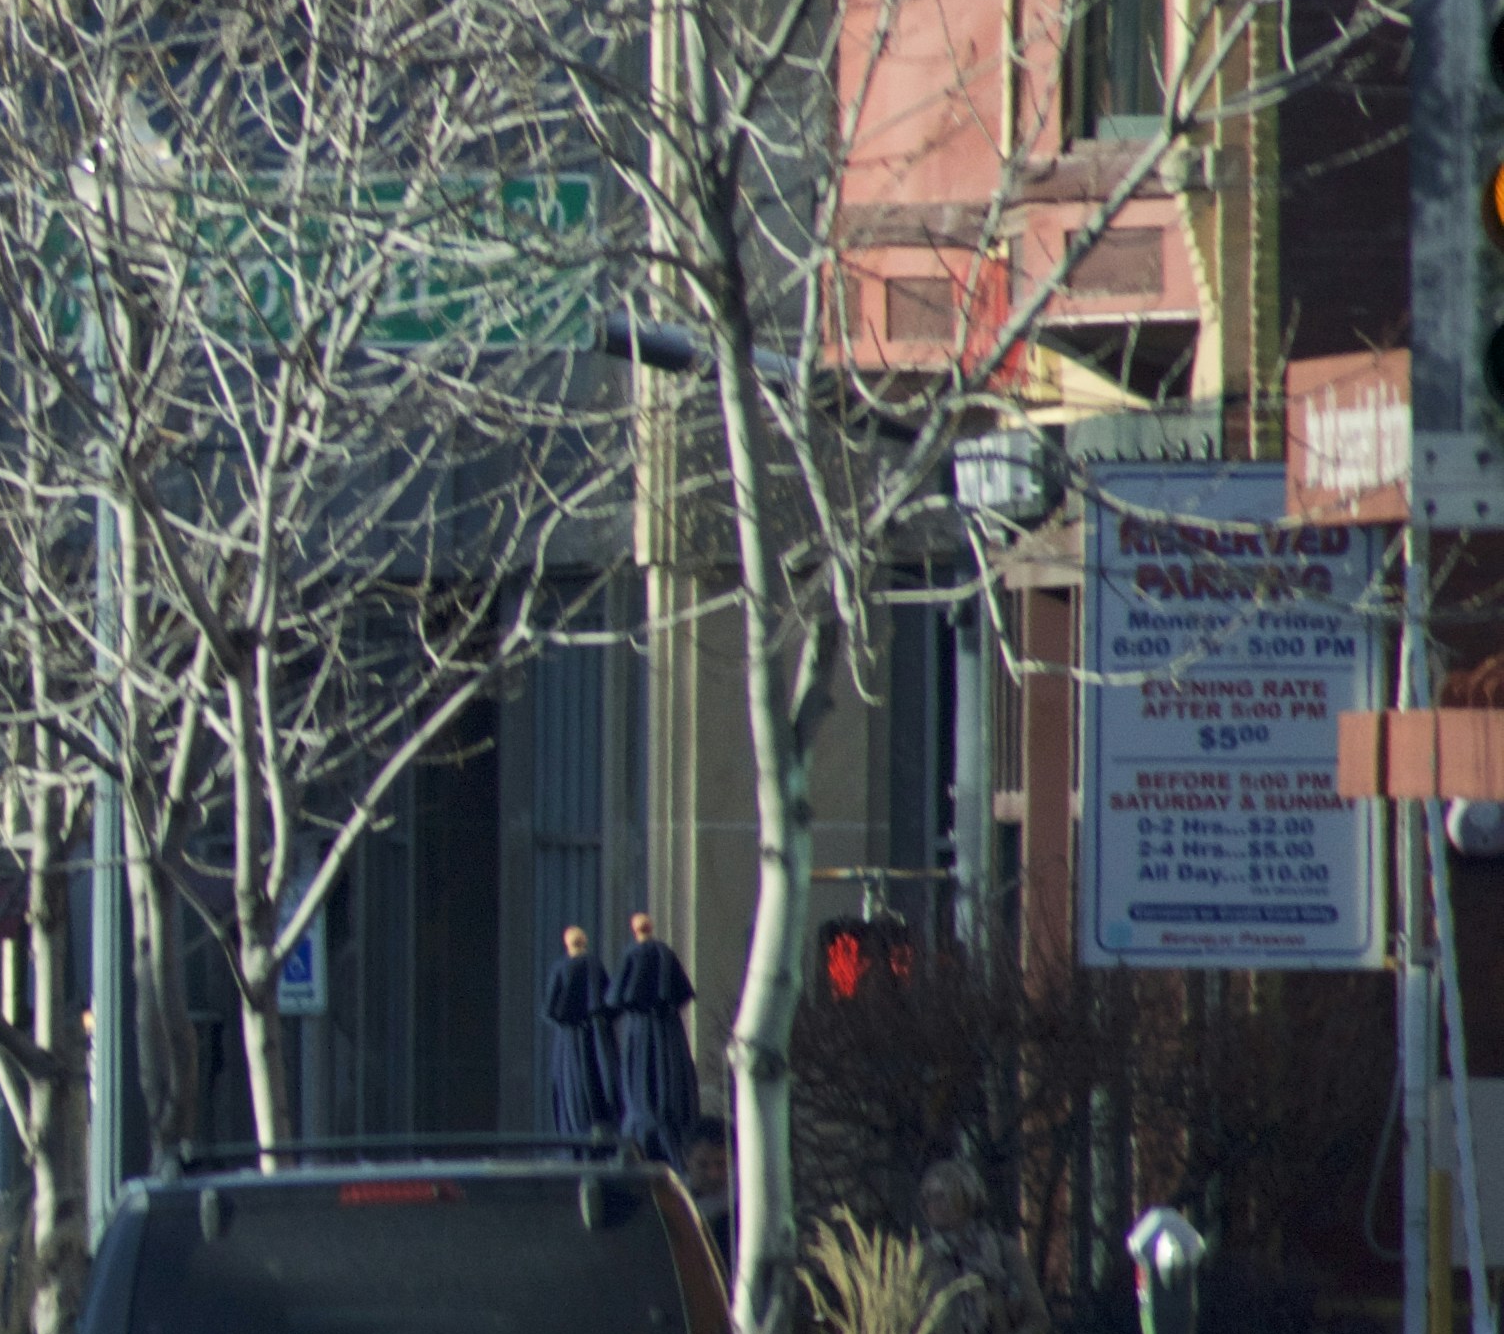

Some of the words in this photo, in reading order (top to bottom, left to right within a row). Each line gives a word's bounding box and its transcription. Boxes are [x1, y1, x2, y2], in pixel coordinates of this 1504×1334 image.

[1314, 636, 1357, 657] PM
[1141, 678, 1255, 699] EVENING
[1262, 679, 1327, 698] RATE
[1142, 701, 1222, 719] AFTER
[1290, 701, 1327, 719] PM
[1136, 771, 1231, 790] BEFORE
[1295, 771, 1334, 790] PM
[1109, 792, 1231, 812] SATURDAY
[1264, 793, 1357, 812] SUNDAY
[1138, 863, 1170, 883] All
